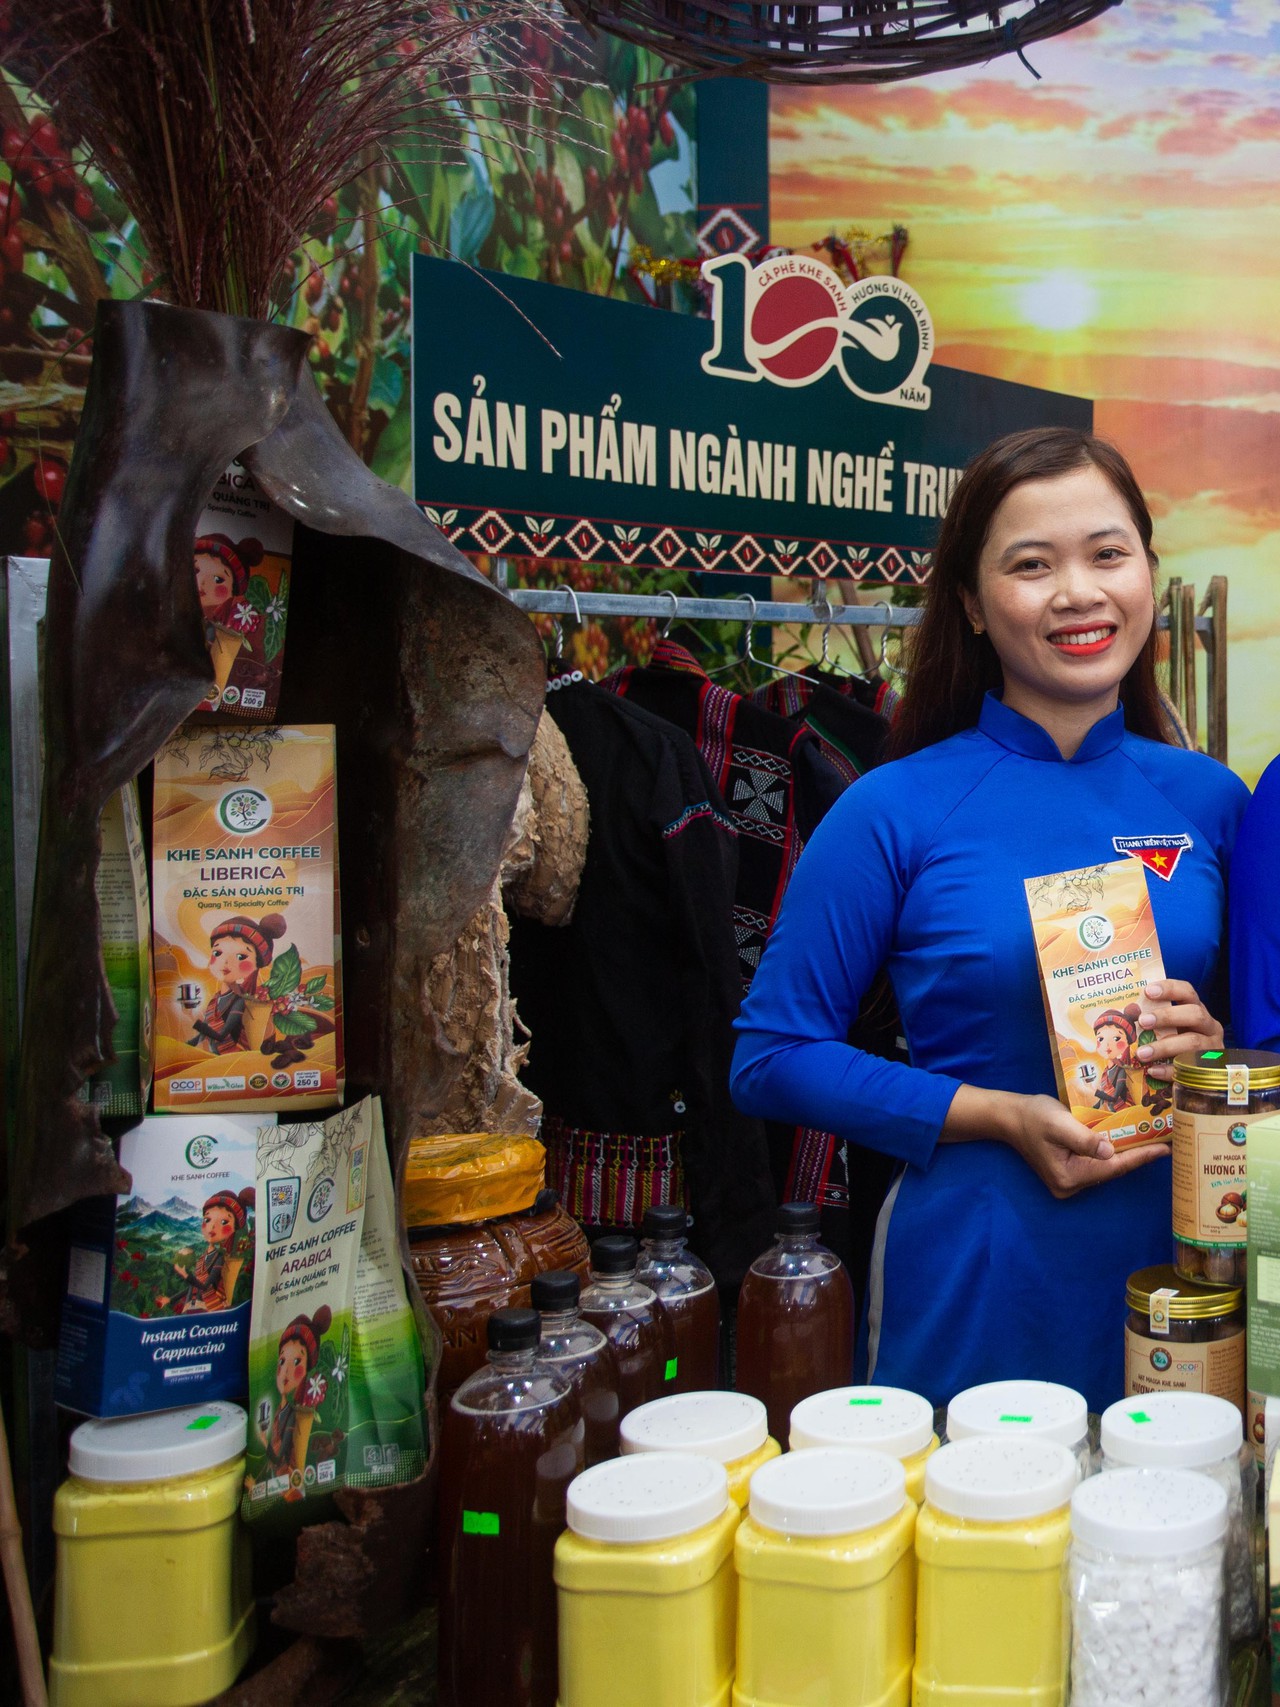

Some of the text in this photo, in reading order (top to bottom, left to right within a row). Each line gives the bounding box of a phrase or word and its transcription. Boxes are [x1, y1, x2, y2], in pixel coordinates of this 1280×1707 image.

[758, 260, 848, 312] CÀ PHÊ KHE SANH
[851, 282, 889, 304] HƯƠNG
[918, 319, 931, 351] BÌNH
[899, 388, 927, 404] NĂM
[433, 374, 963, 519] SẢN PHẨM NGÀNH NGHỀ TRU
[167, 846, 320, 862] KHE SANH COFFEE
[200, 866, 286, 882] LIBERICA
[183, 885, 305, 900] ĐẶC SẢN QUẢNG TRỊ
[197, 900, 222, 910] Quang
[233, 899, 265, 909] Specialty
[267, 898, 290, 907] Coffee
[1052, 948, 1152, 979] KHE SANH COFFEE
[1076, 968, 1134, 989] LIBERICA
[1068, 993, 1086, 1004] ĐẶC
[1087, 989, 1104, 1000] SẢN
[1105, 983, 1134, 996] QUẢNG
[171, 1080, 201, 1090] OCOP
[297, 1079, 311, 1087] 250
[171, 1171, 230, 1182] KHE SANH COFFEE
[1203, 1163, 1235, 1175] HƯƠNG
[265, 1220, 357, 1262] KHE SANH COFFEE
[280, 1247, 333, 1275] ARABICA
[141, 1321, 239, 1345] Instant Coconut
[153, 1341, 226, 1361] Cappuccino
